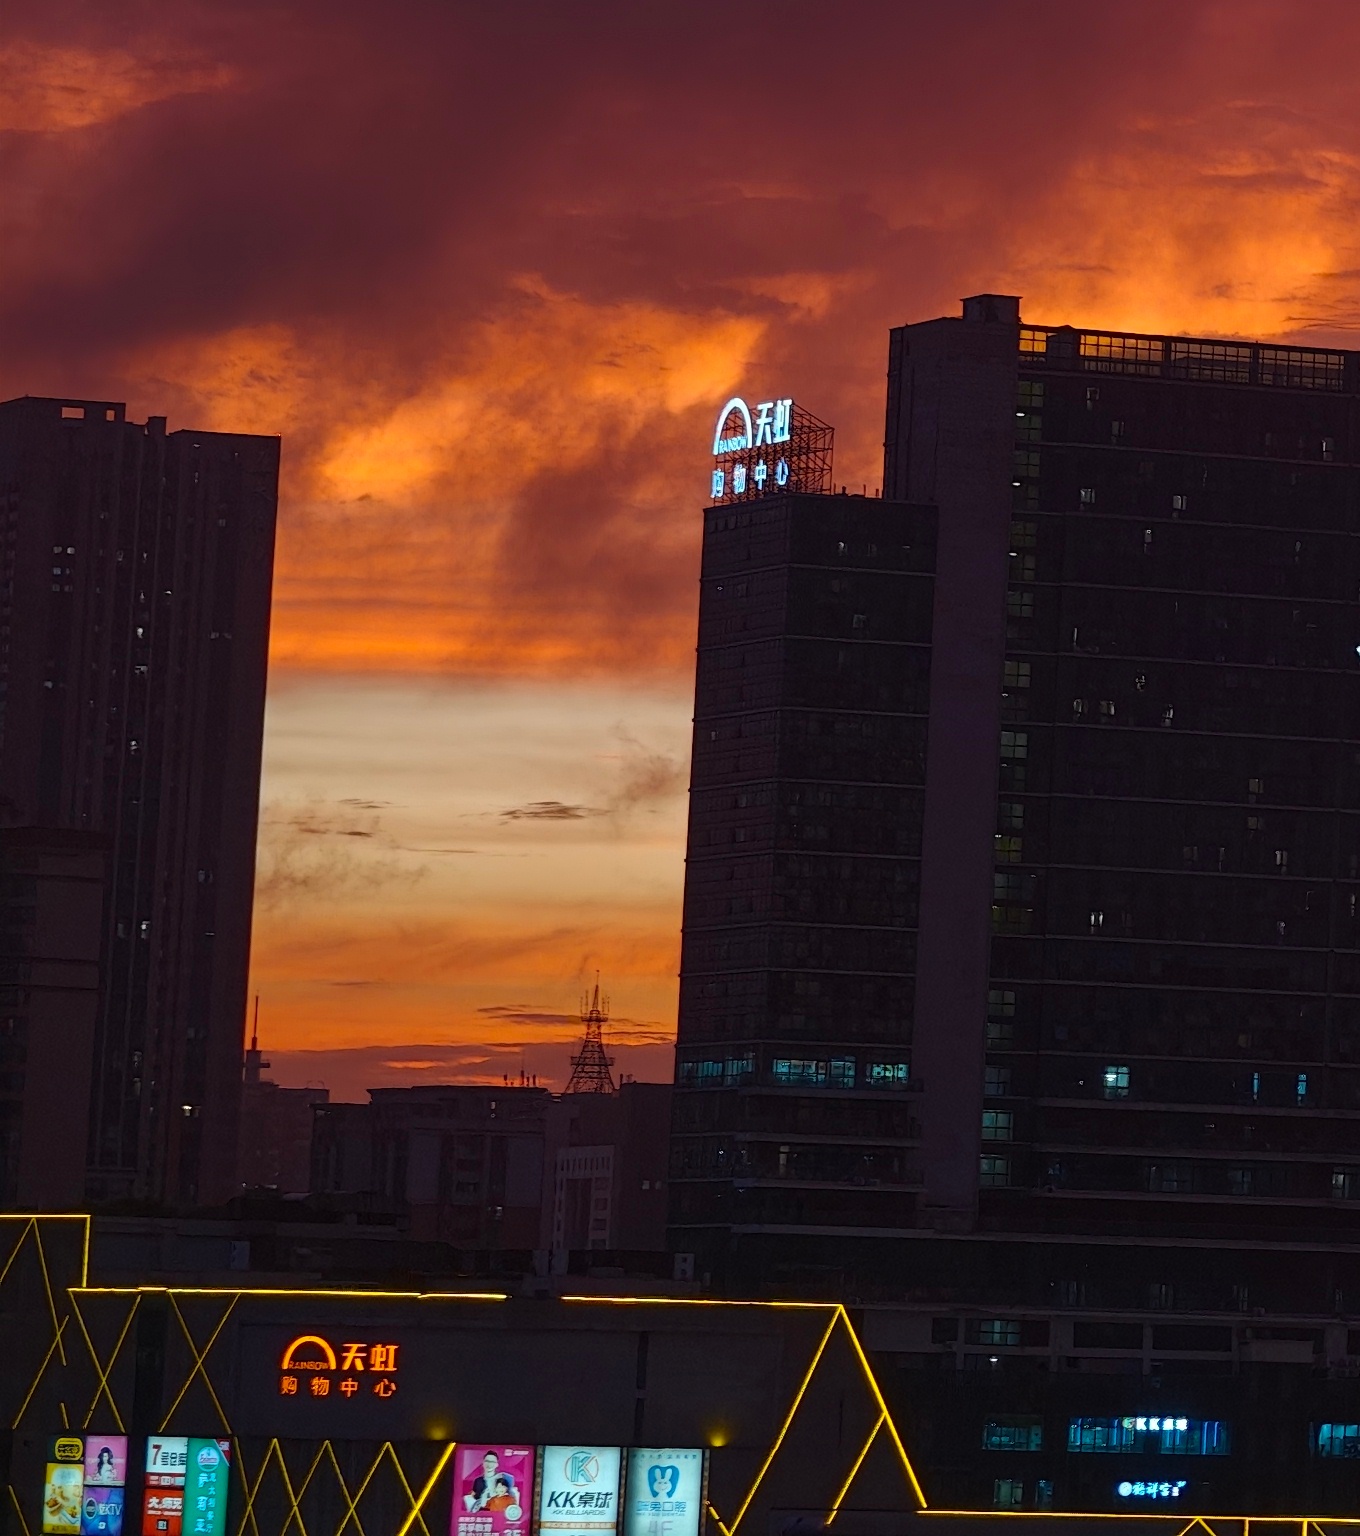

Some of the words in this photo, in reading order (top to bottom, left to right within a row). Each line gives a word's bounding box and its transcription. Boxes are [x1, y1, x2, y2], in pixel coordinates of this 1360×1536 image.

[756, 399, 792, 447] 天虹
[718, 436, 748, 454] RAINBOW
[710, 456, 789, 499] 购物中心
[289, 1361, 329, 1370] RAINBOW
[341, 1343, 399, 1371] 天虹
[280, 1376, 397, 1398] 购物中心
[547, 1490, 614, 1508] KK桌球
